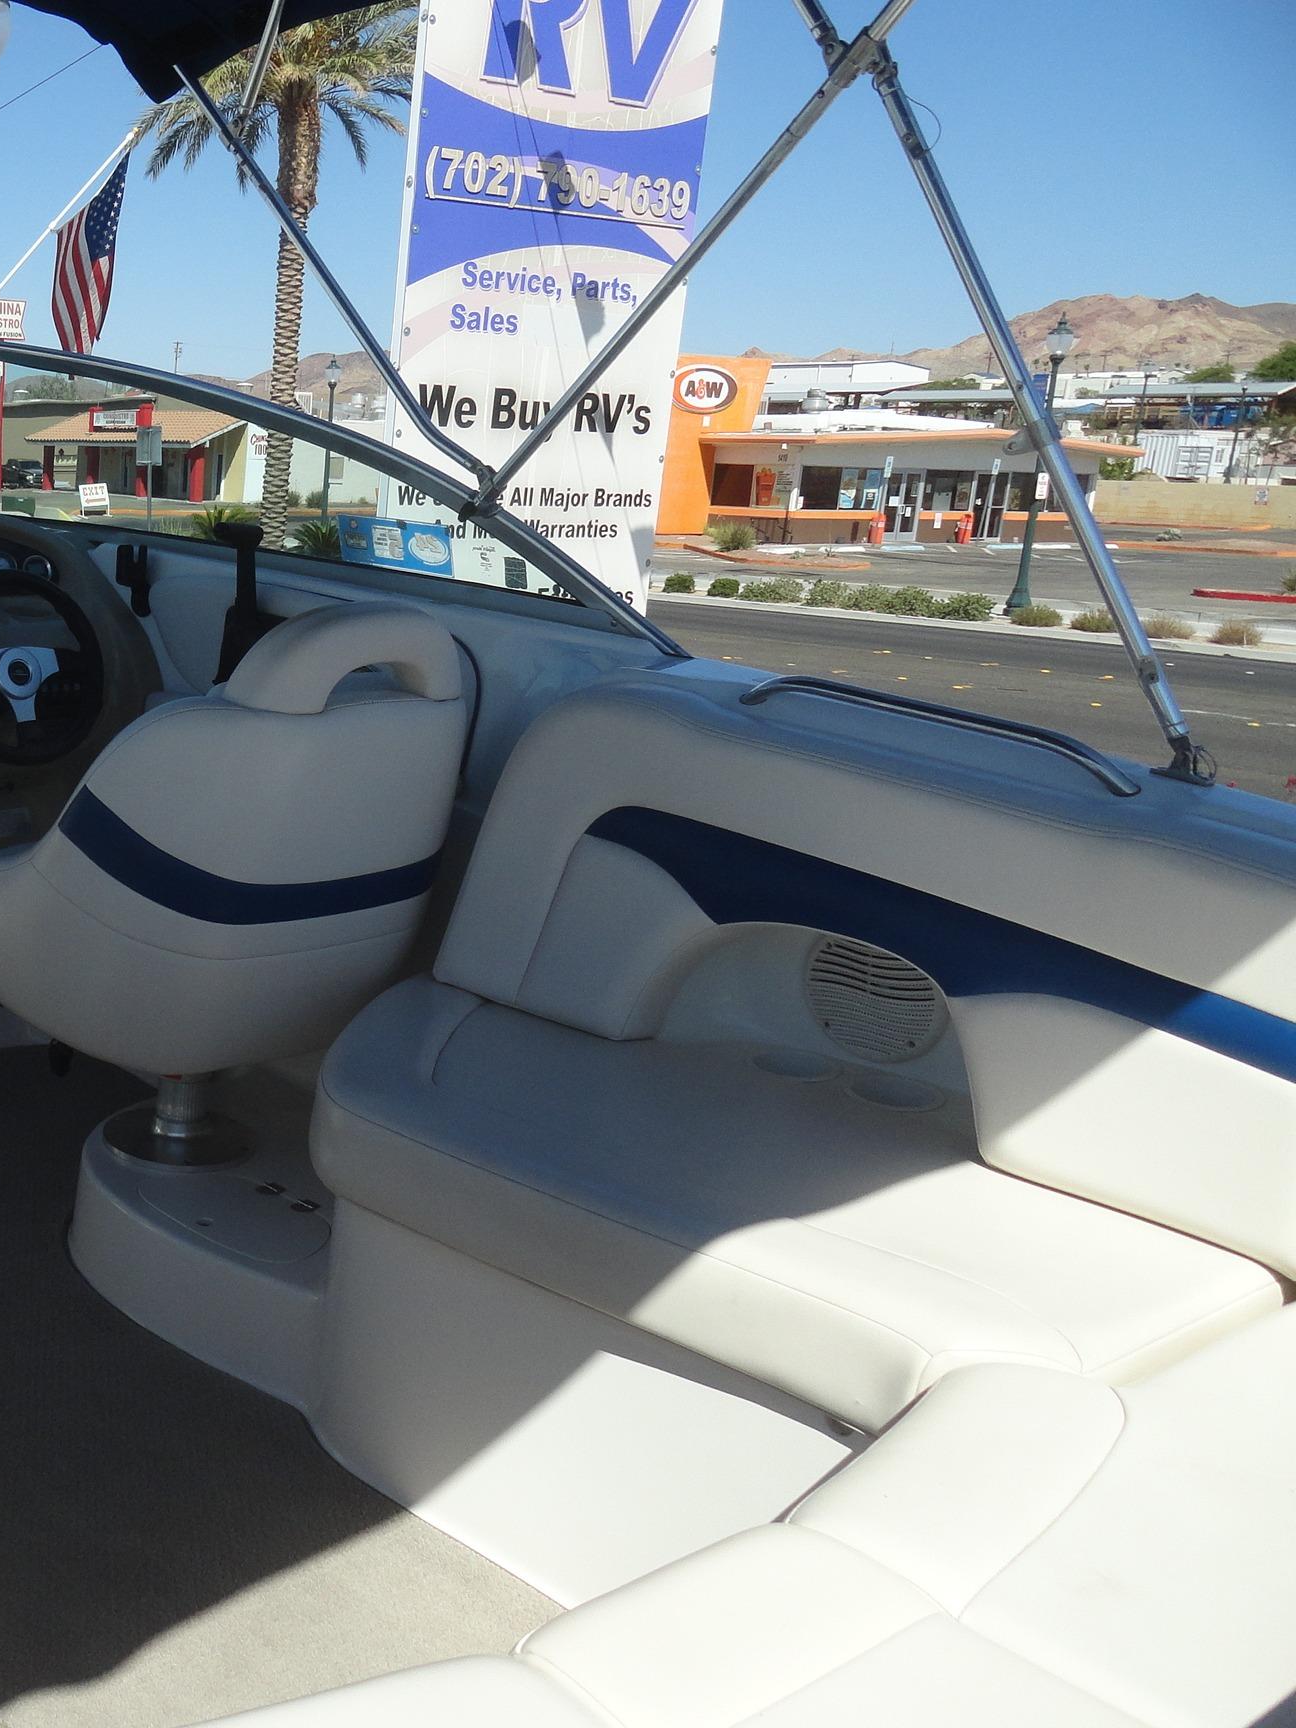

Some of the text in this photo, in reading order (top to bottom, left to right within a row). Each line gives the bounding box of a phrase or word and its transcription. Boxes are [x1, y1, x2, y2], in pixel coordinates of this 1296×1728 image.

[479, 0, 697, 108] RV
[426, 145, 692, 220] (702) 790-1639
[461, 261, 637, 307] Service, Parts,
[449, 303, 518, 334] Sales
[684, 378, 724, 399] A&W
[418, 384, 477, 429] We
[573, 392, 651, 435] RV's
[82, 485, 105, 496] EXIT
[397, 485, 427, 507] We
[509, 487, 534, 507] All
[539, 487, 589, 512] Major
[593, 488, 652, 508] Brands
